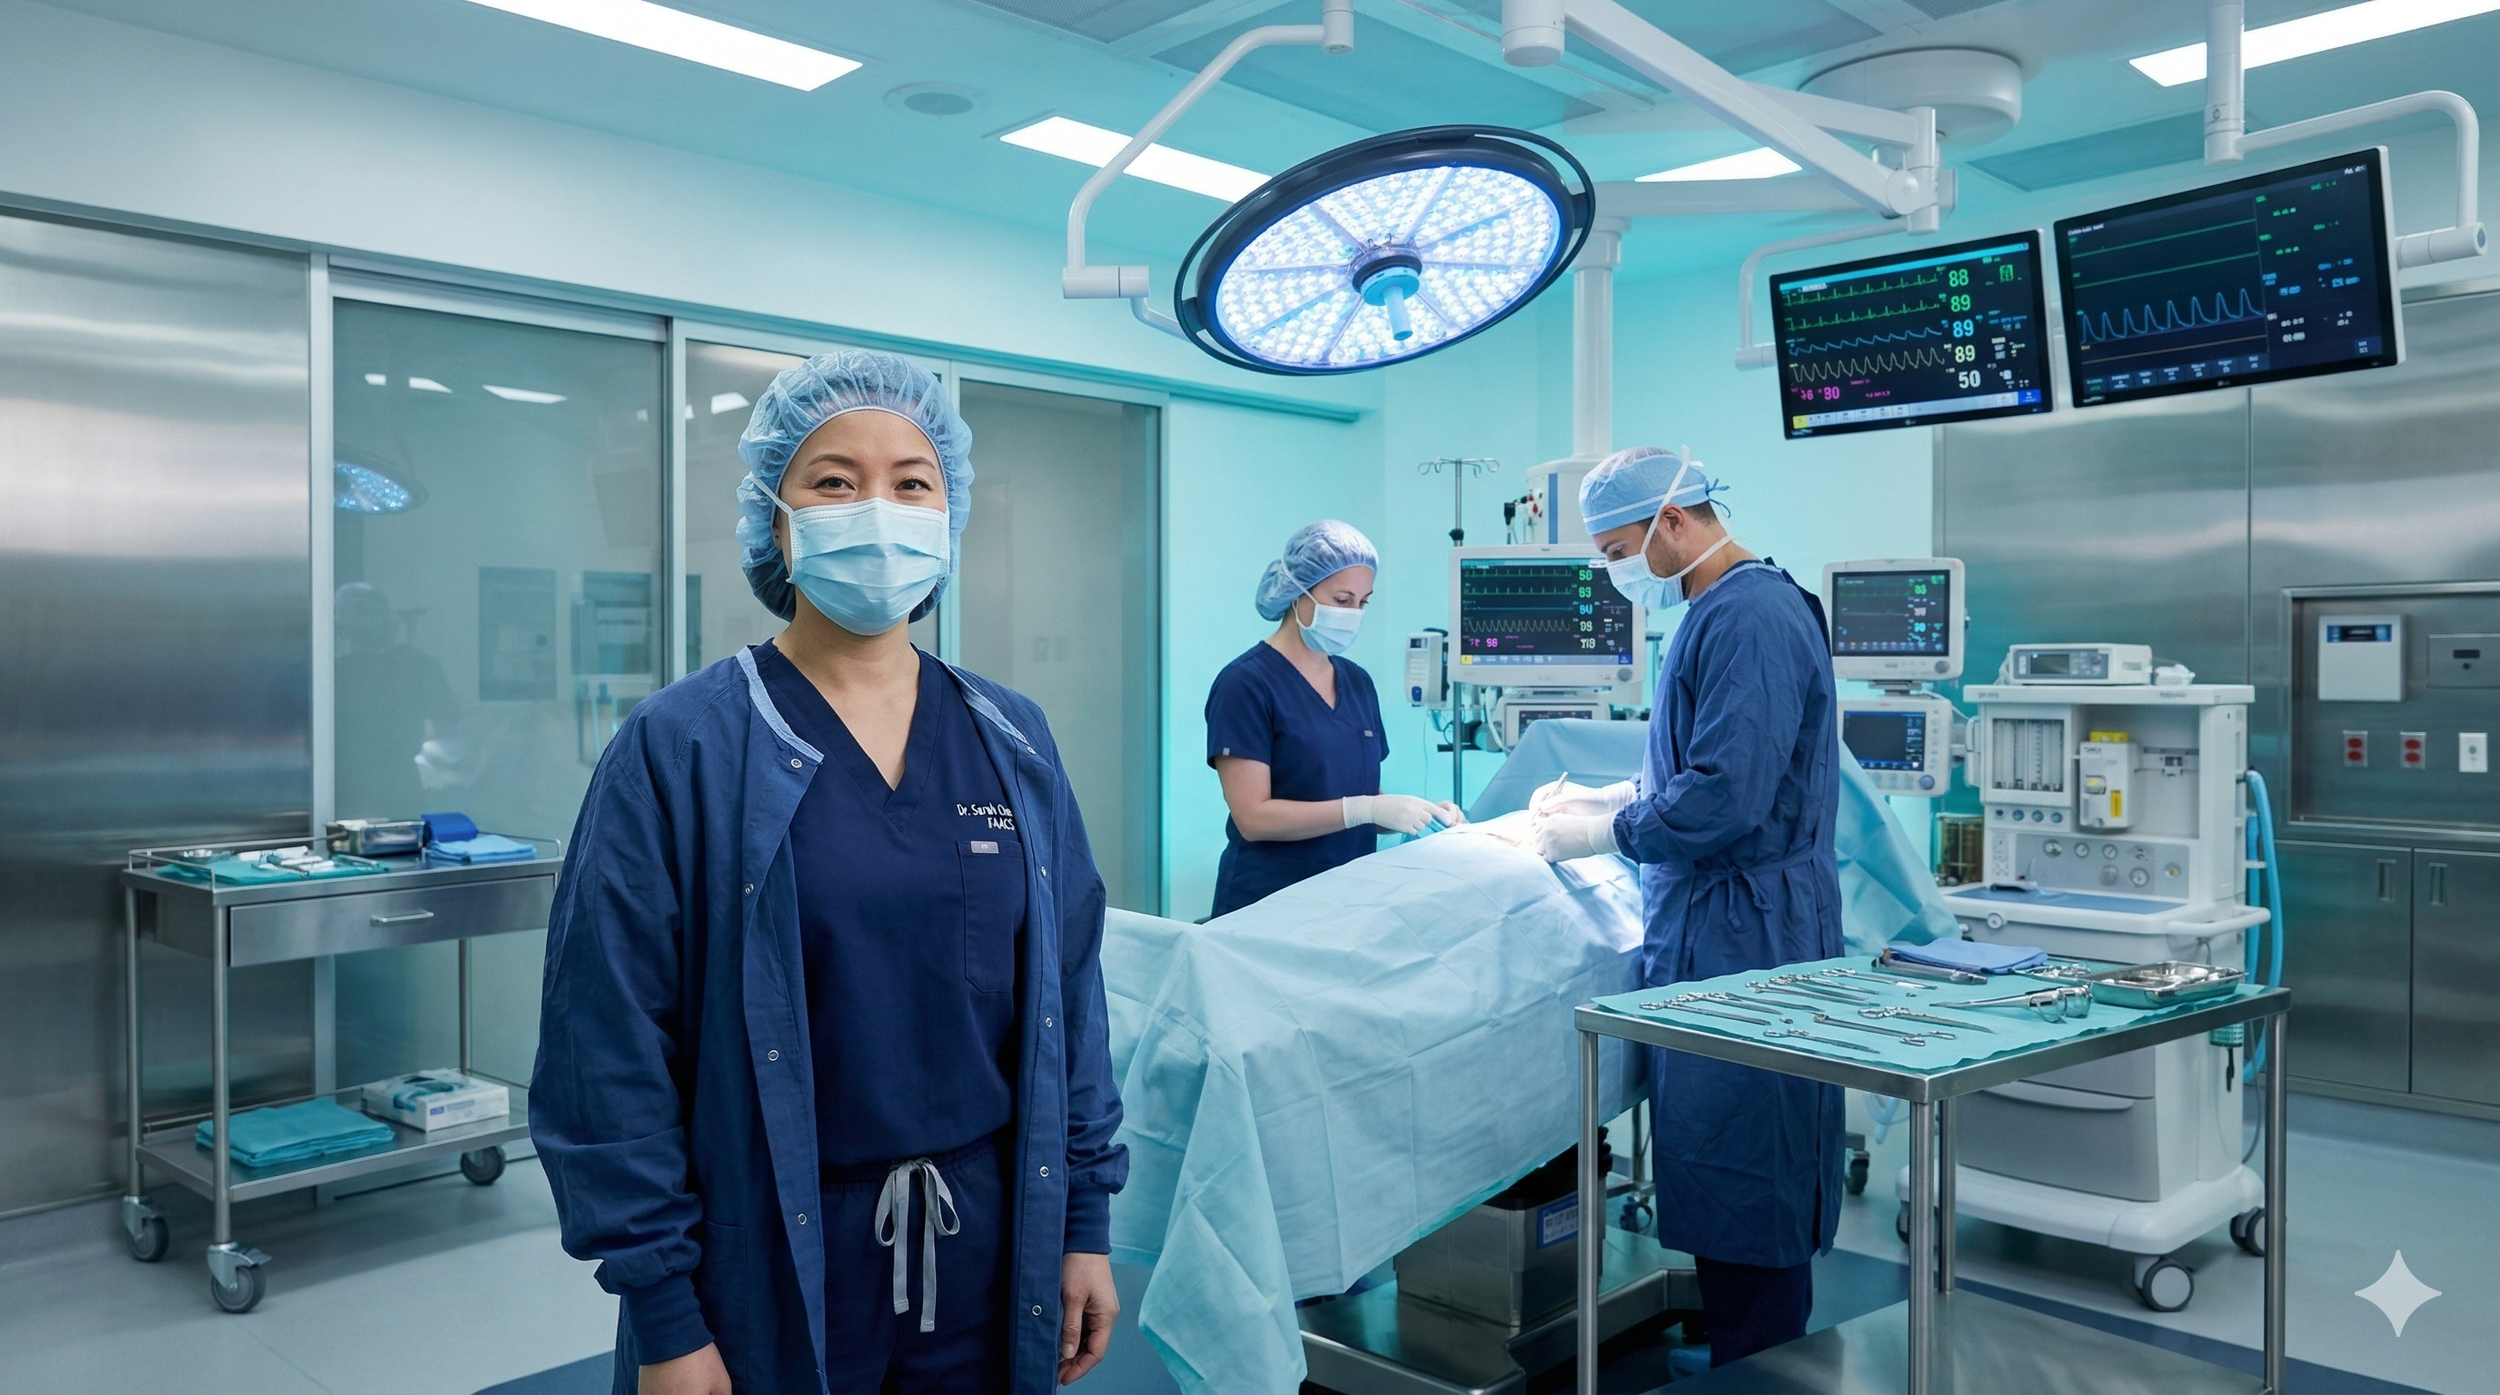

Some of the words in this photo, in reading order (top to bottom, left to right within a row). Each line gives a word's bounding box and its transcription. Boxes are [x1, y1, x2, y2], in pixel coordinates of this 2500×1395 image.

[1949, 268, 1970, 287] 88
[1951, 294, 1971, 312] 89
[1953, 319, 1974, 338] 89
[1955, 344, 1976, 363] 89
[1958, 370, 1981, 389] 50
[956, 803, 971, 816] Dr.
